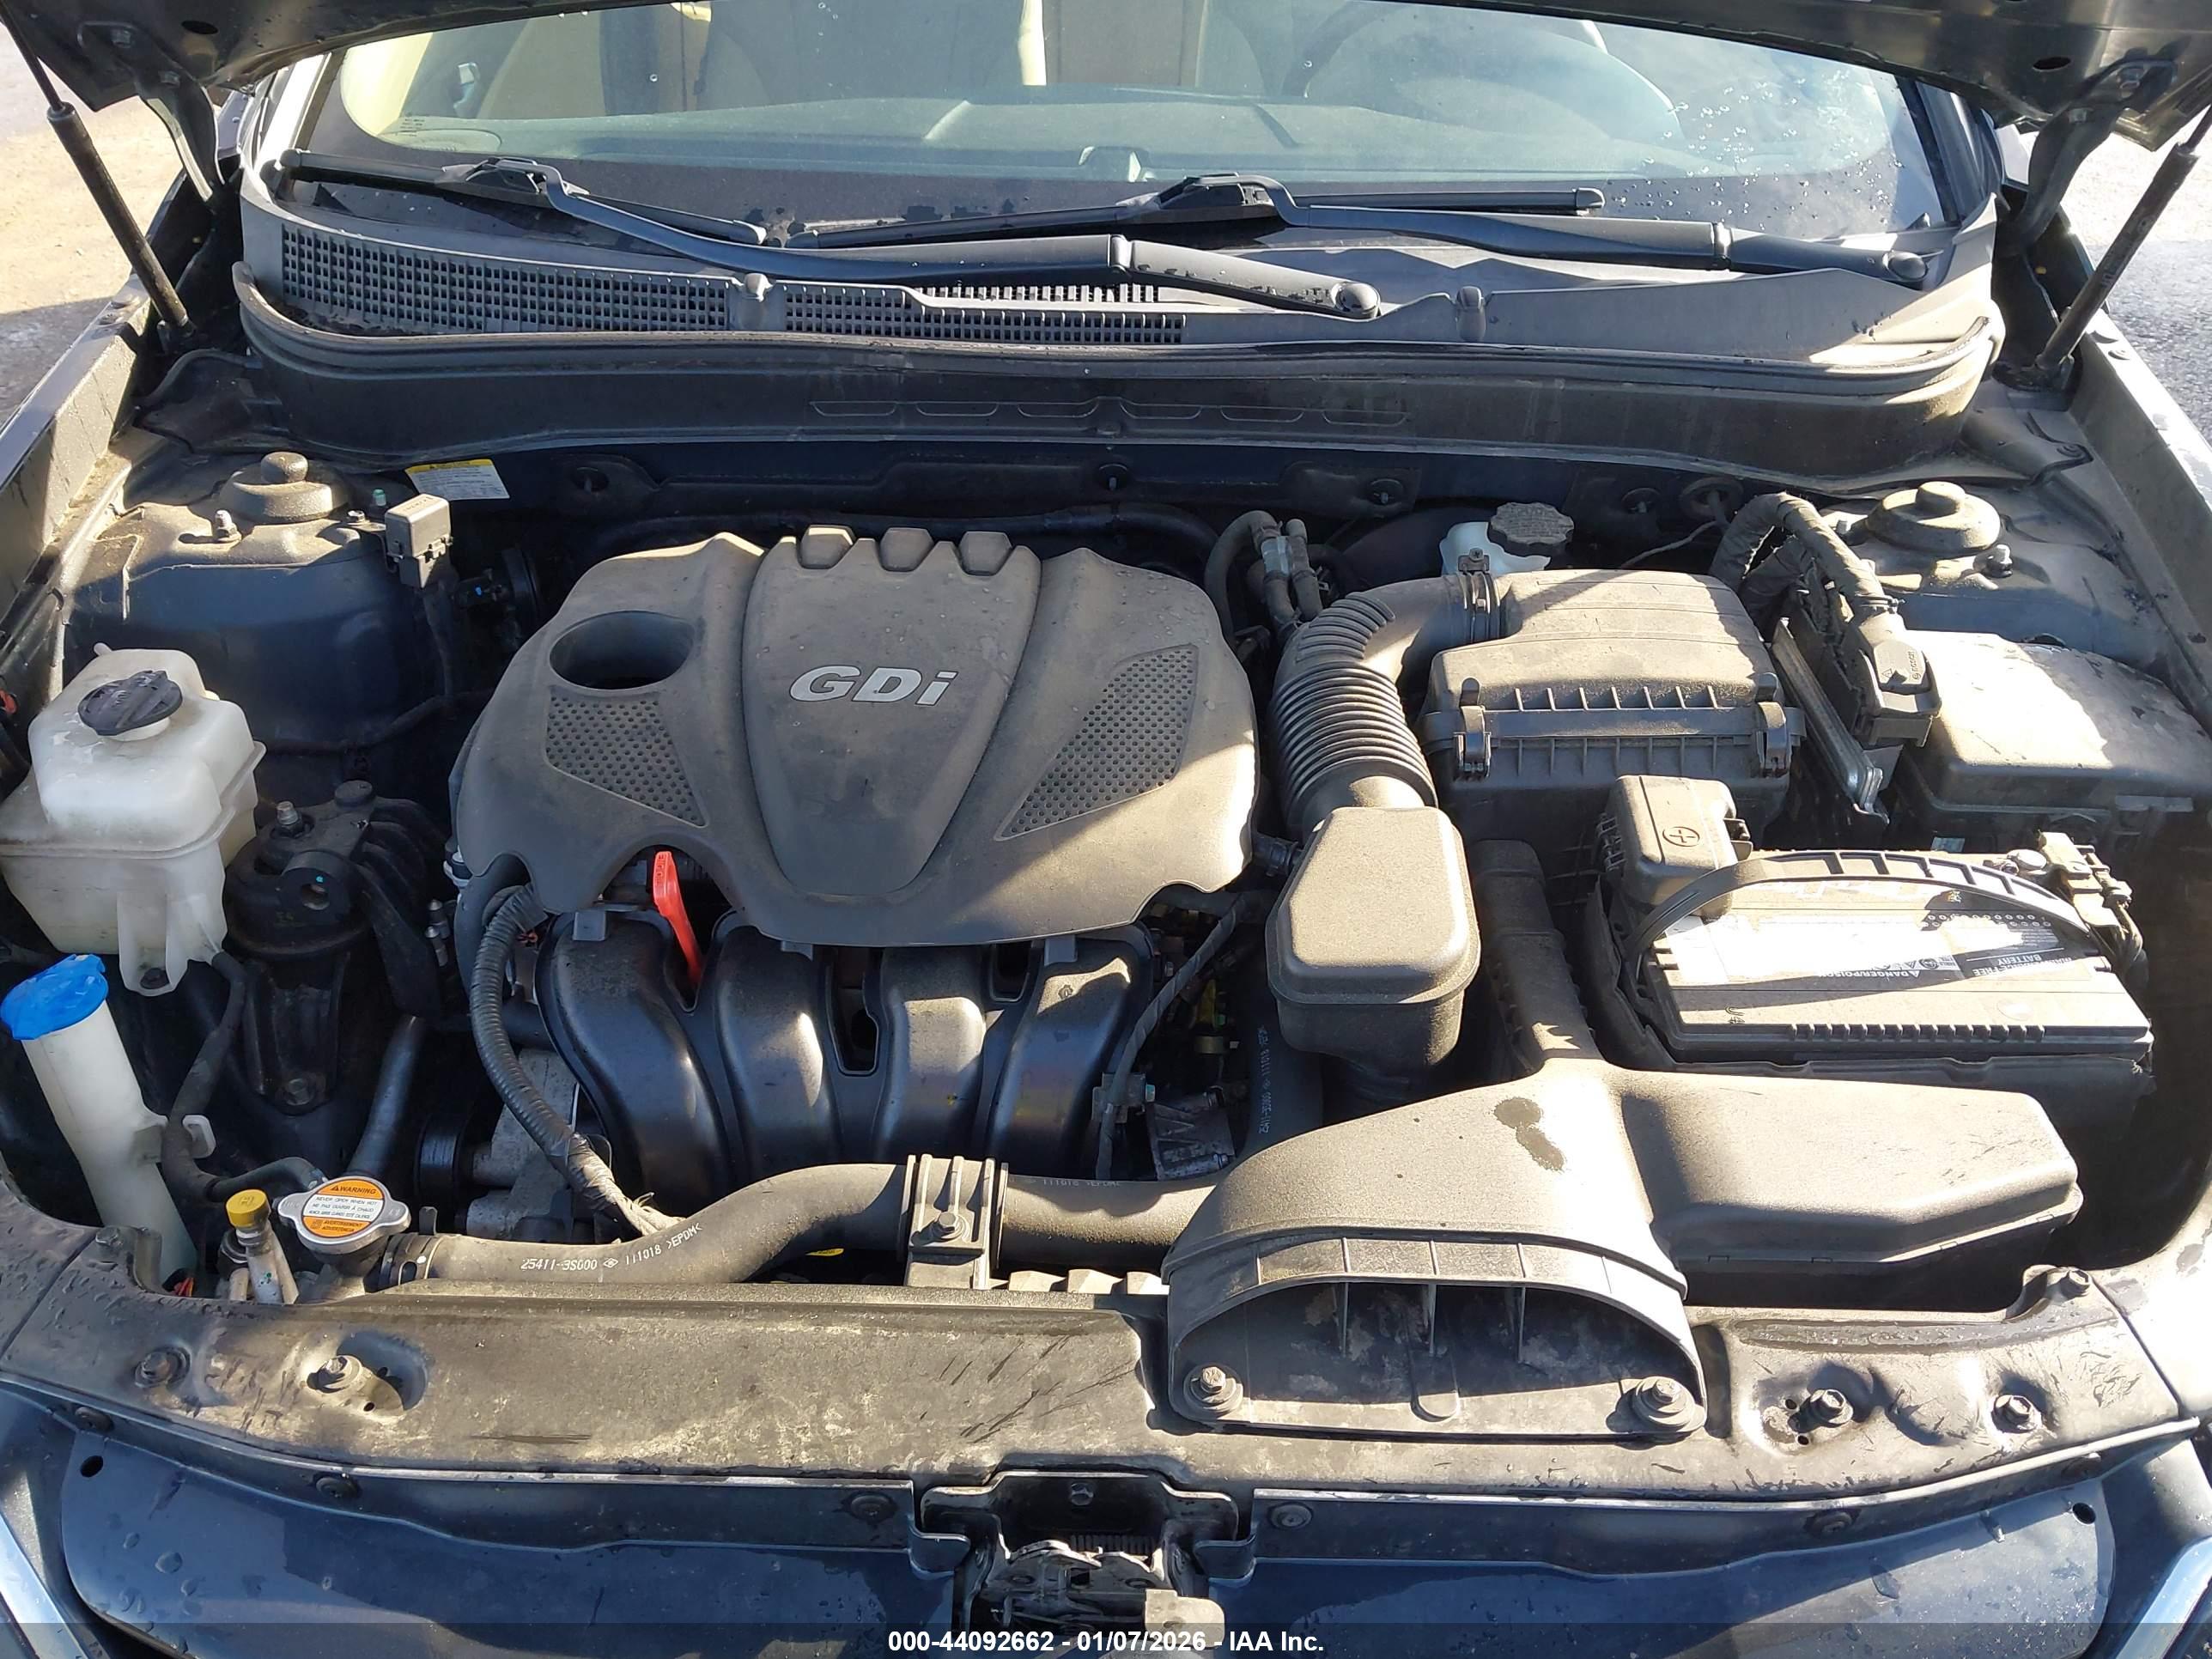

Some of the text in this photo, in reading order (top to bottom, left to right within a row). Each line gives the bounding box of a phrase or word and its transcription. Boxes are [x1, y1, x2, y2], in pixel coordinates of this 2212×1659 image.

[789, 665, 959, 706] GDi
[1997, 953, 2043, 966] BATTERY
[340, 1186, 377, 1194] WARNING
[625, 1244, 662, 1265] 111018
